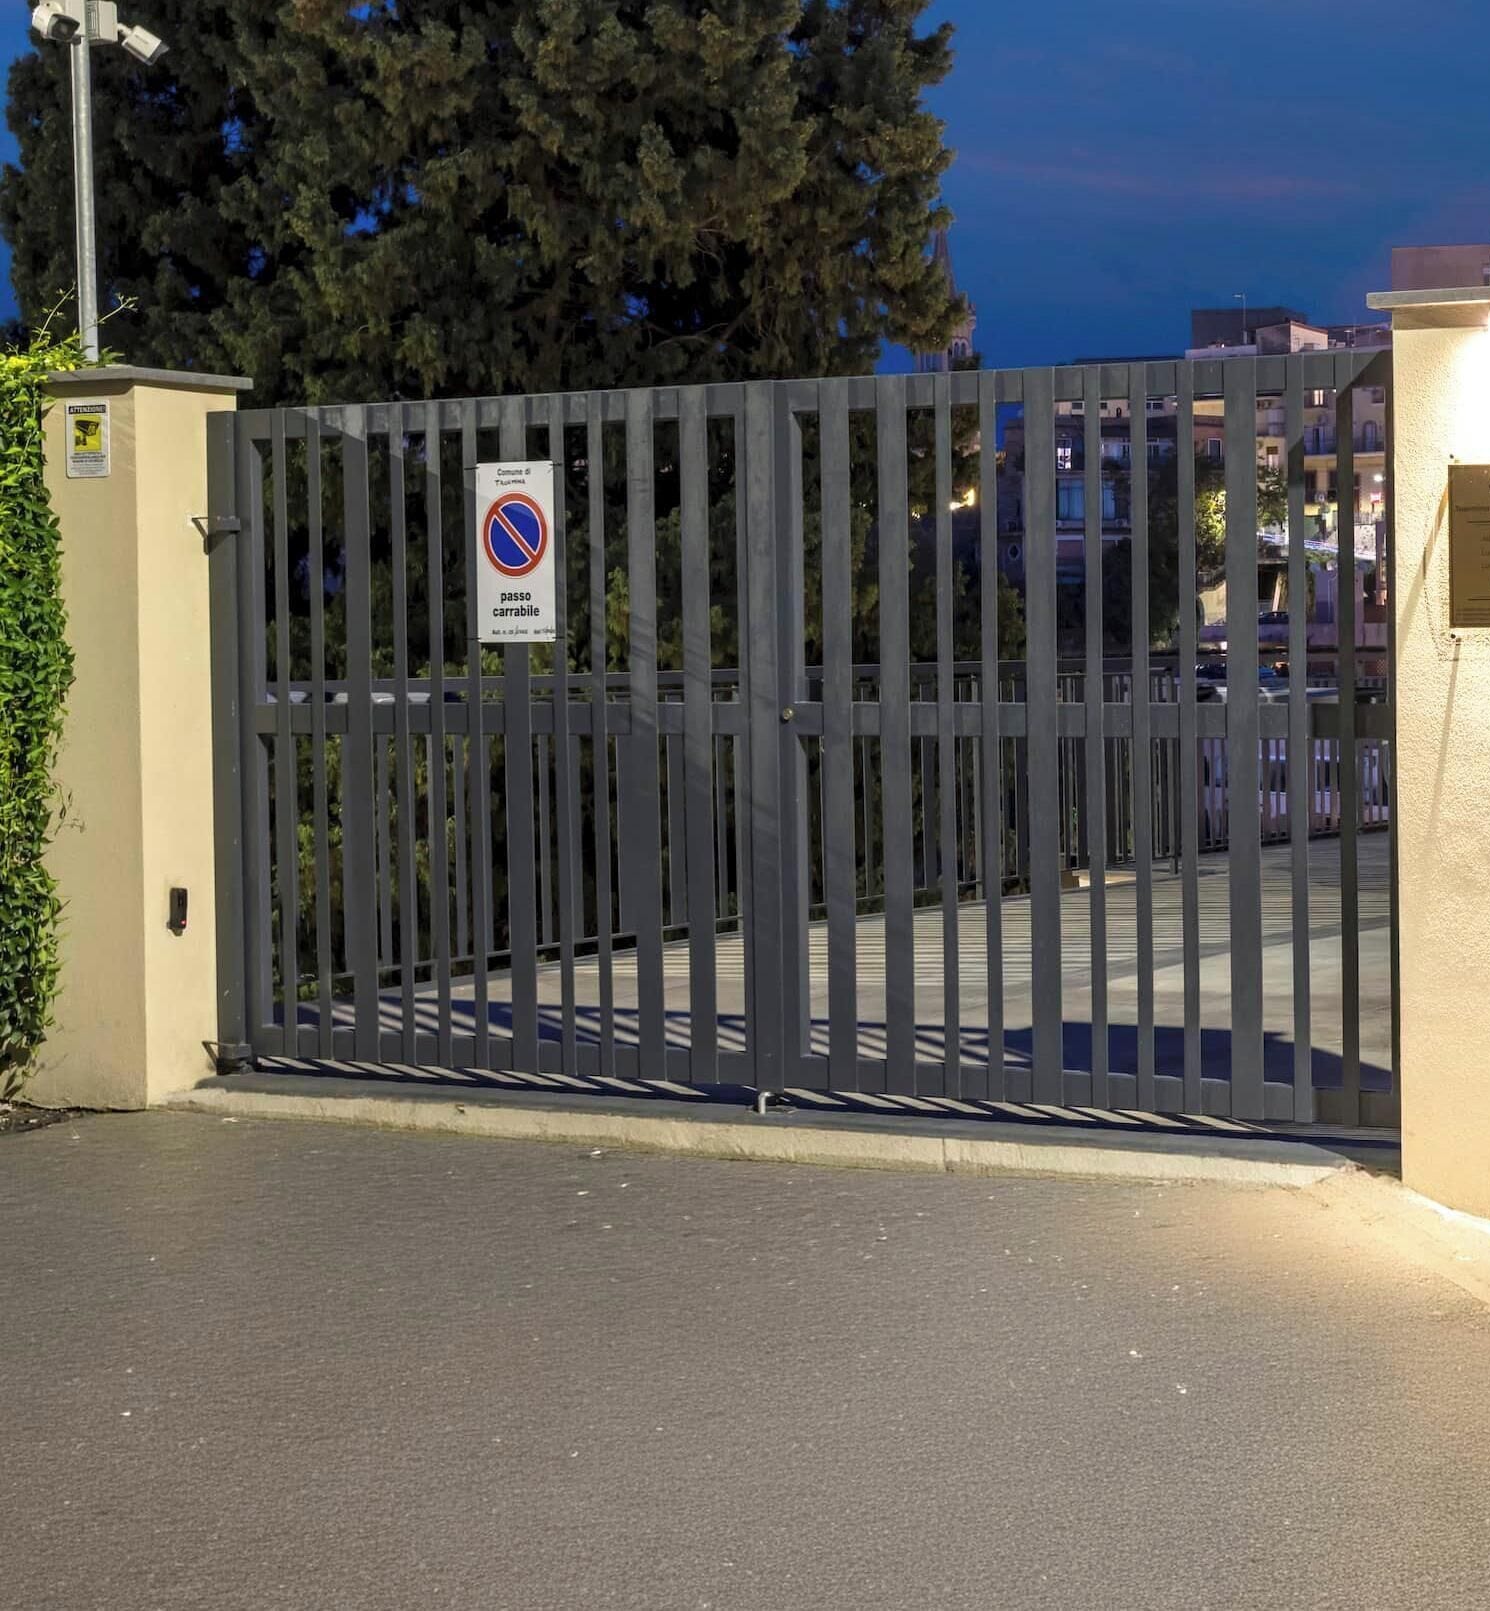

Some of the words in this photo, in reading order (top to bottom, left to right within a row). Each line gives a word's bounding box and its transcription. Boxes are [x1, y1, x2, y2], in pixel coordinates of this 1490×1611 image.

[525, 467, 531, 475] di
[501, 592, 531, 604] passo
[493, 605, 540, 617] carrabile
